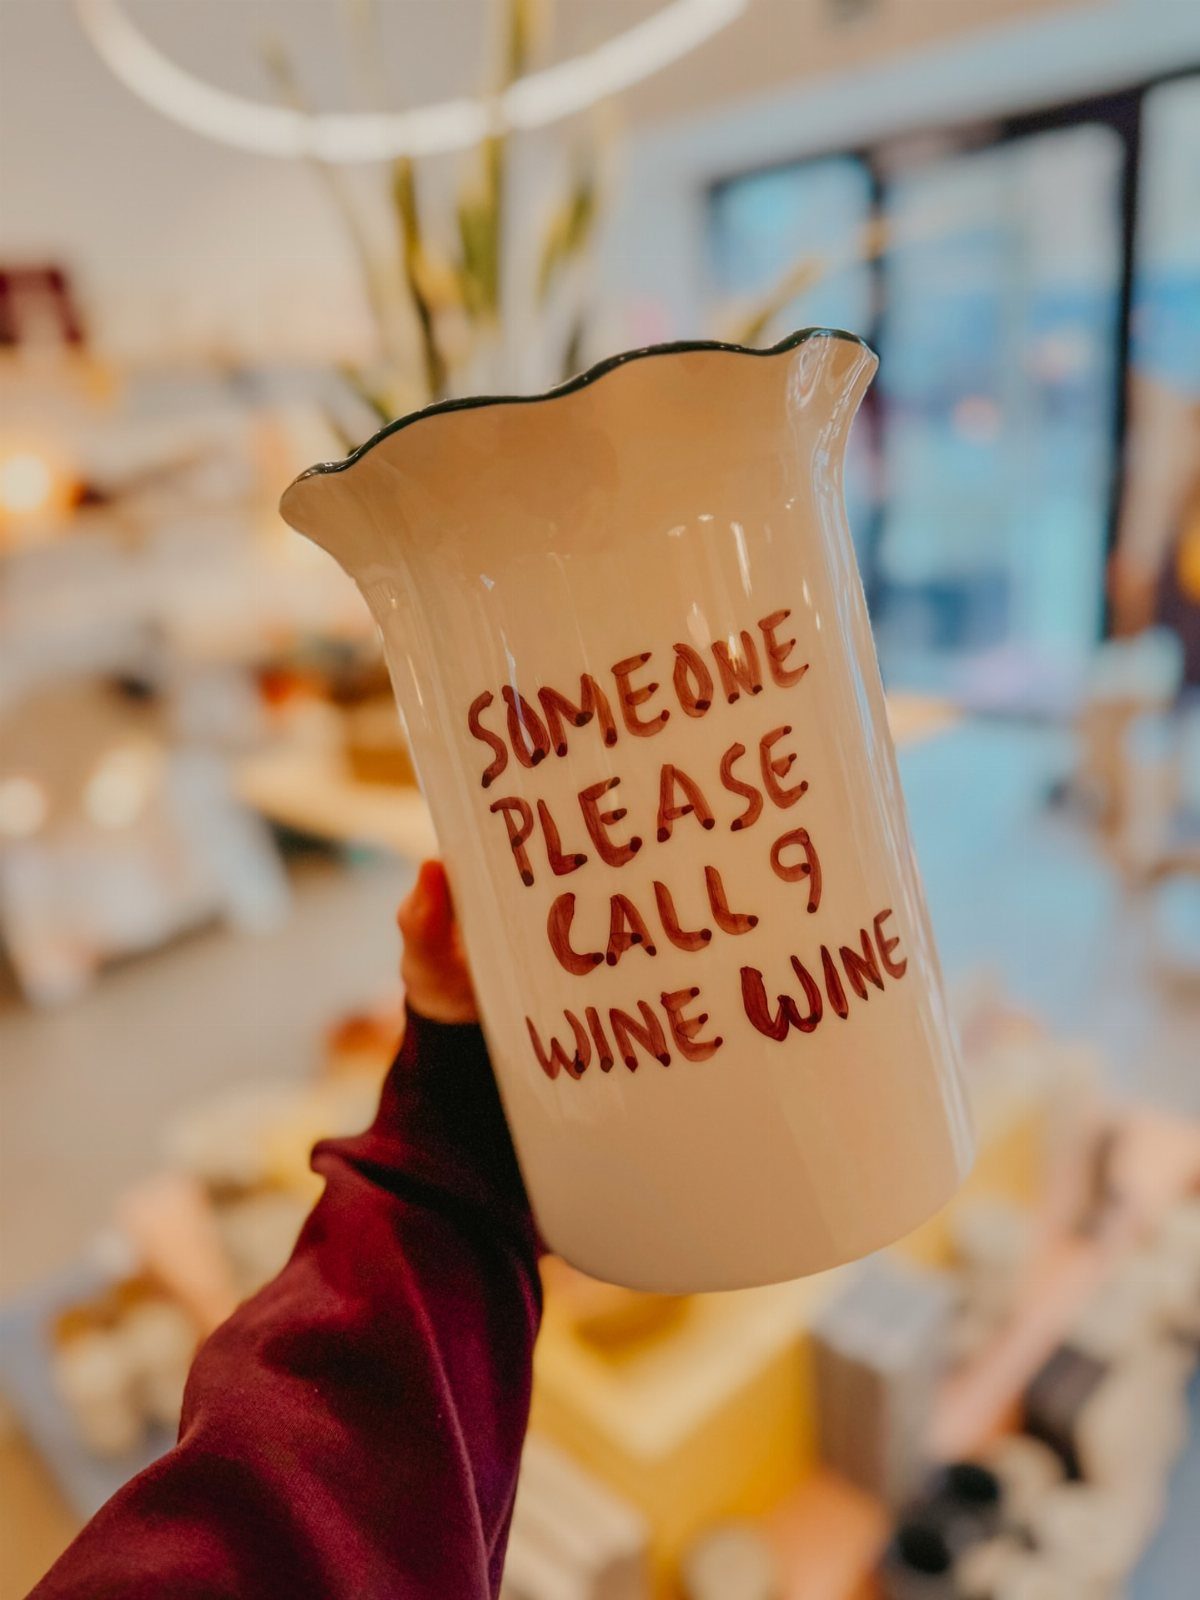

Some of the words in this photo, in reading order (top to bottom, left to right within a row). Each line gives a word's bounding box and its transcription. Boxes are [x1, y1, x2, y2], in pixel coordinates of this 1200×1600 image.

[468, 609, 810, 789] SOMEONE
[489, 725, 809, 888] PLEASE
[546, 865, 759, 977] CALL
[769, 827, 823, 914] 9
[525, 987, 724, 1081] WINE
[740, 908, 908, 1043] WINE
